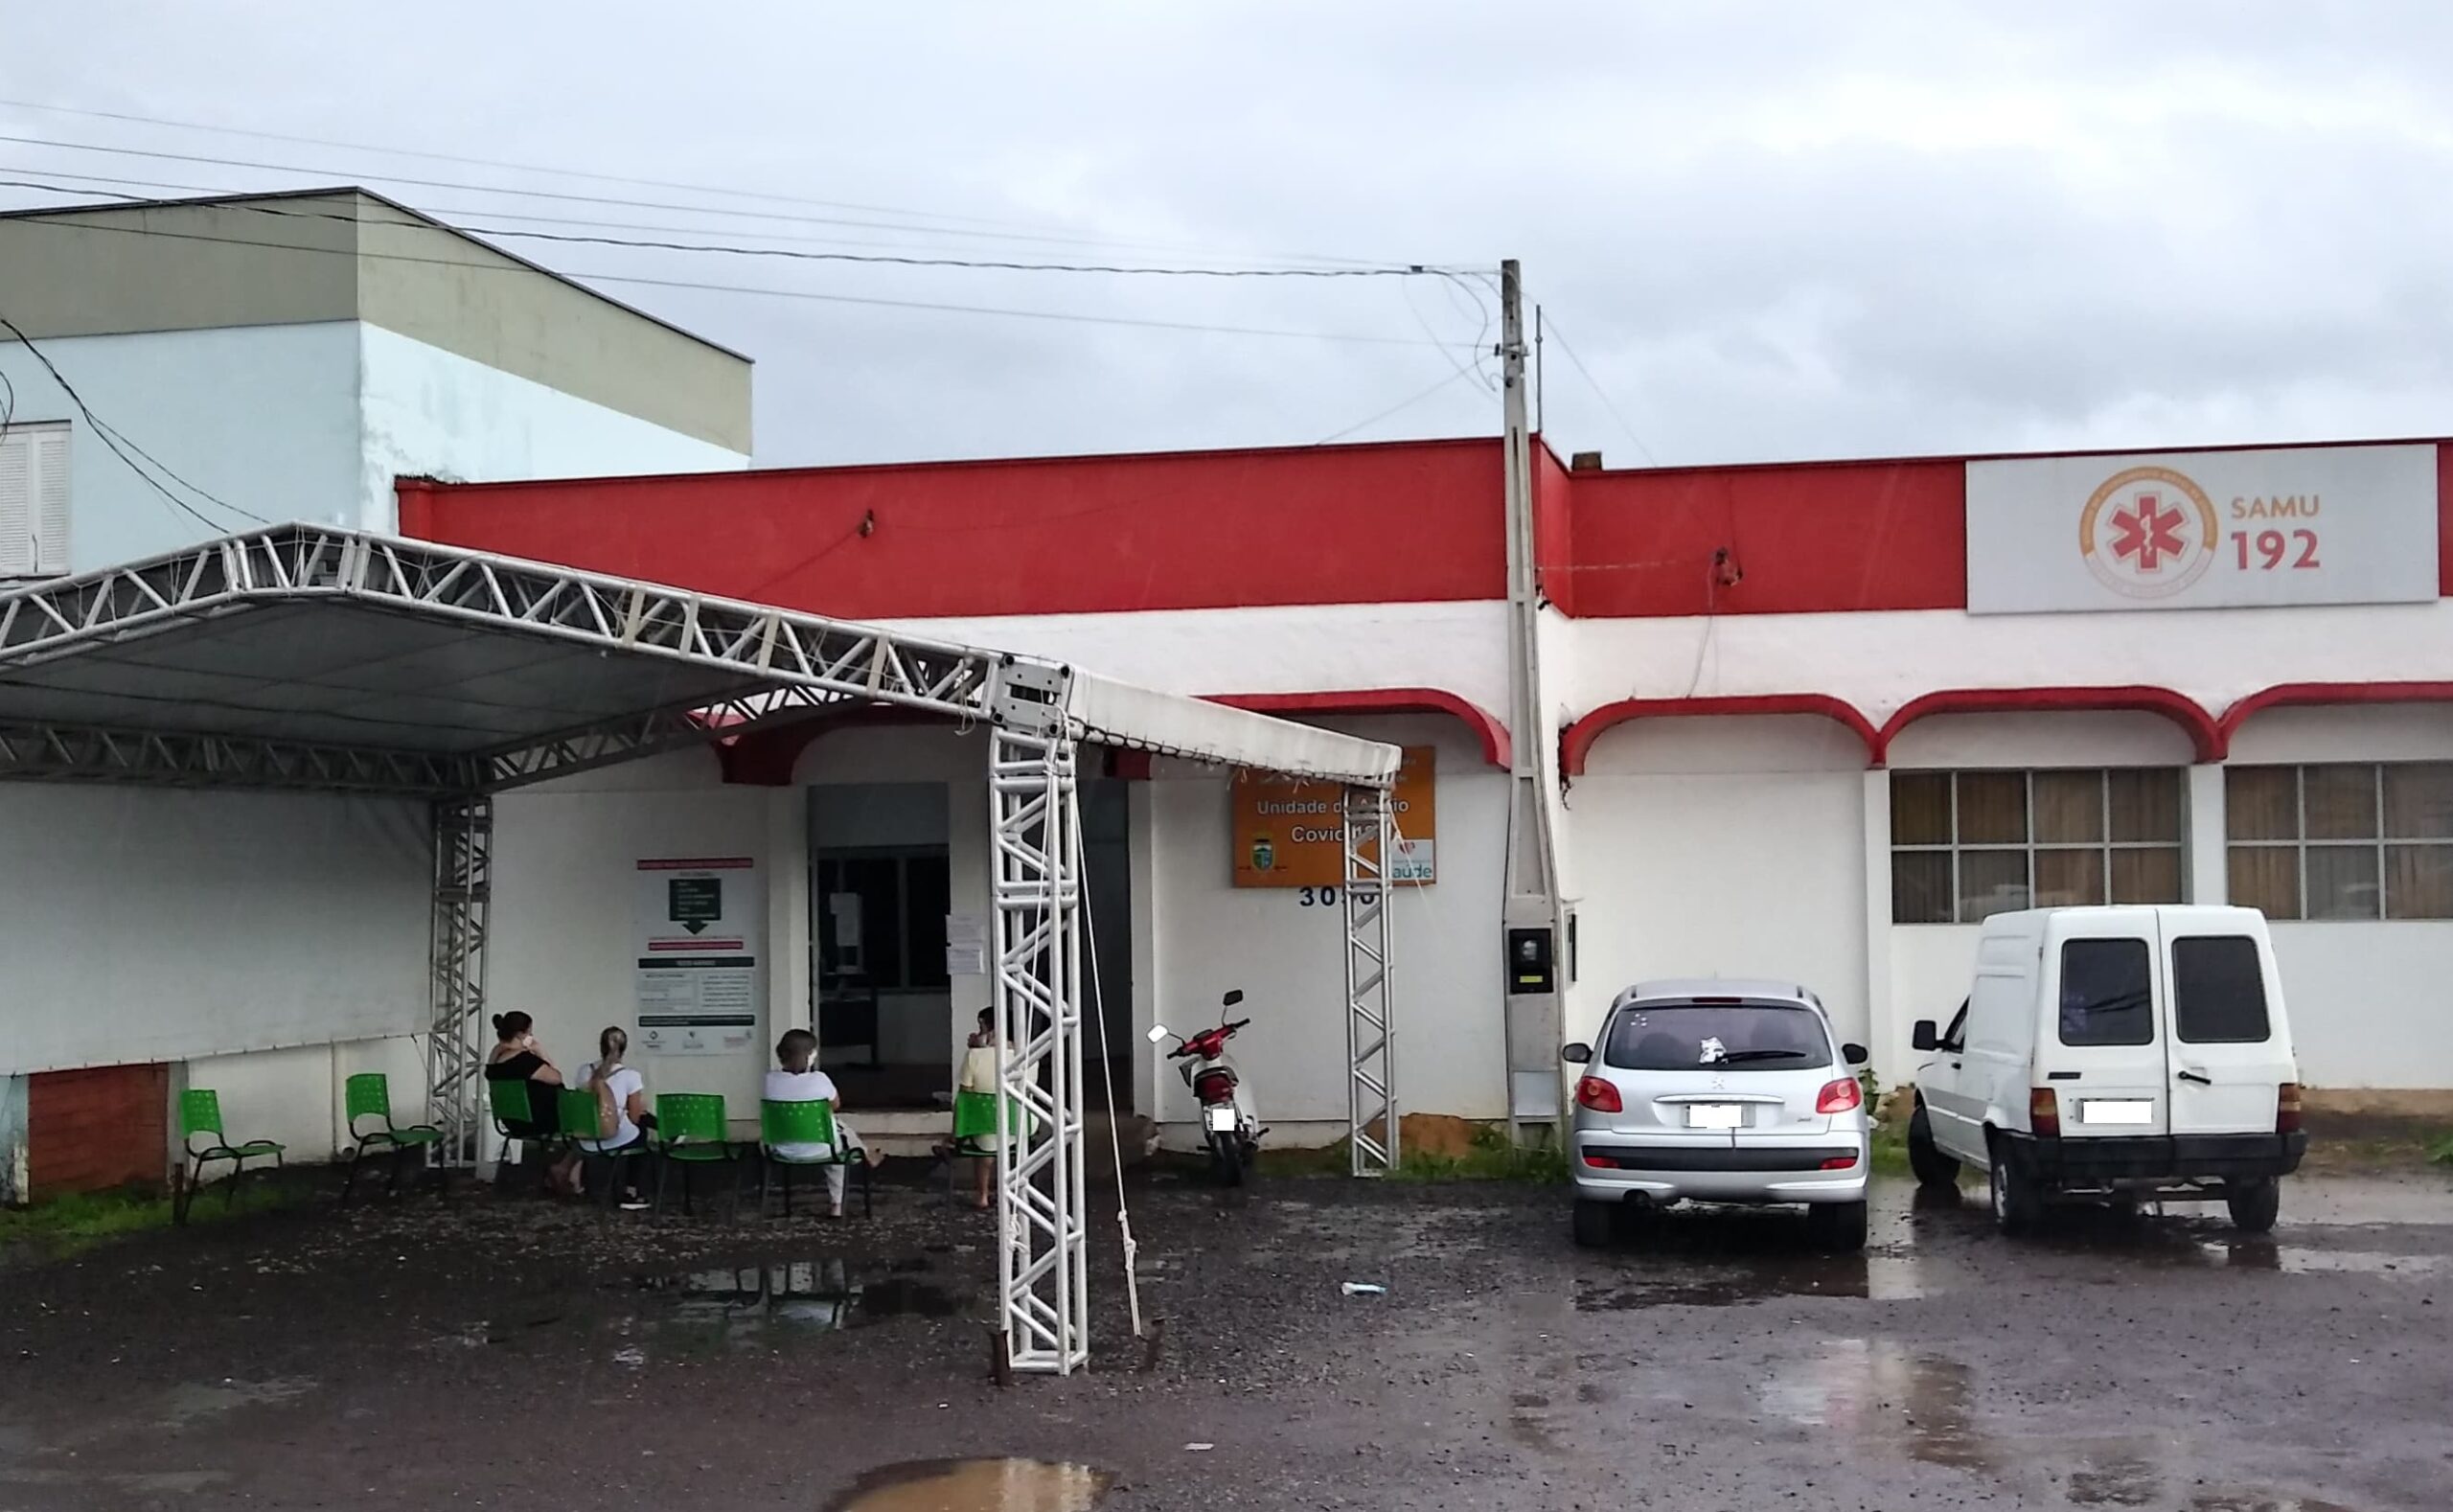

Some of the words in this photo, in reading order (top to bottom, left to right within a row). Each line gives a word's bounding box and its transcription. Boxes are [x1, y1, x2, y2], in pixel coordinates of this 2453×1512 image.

[2230, 494, 2321, 519] SAMU
[2230, 529, 2321, 570] 192
[1256, 798, 1327, 814] Unidade
